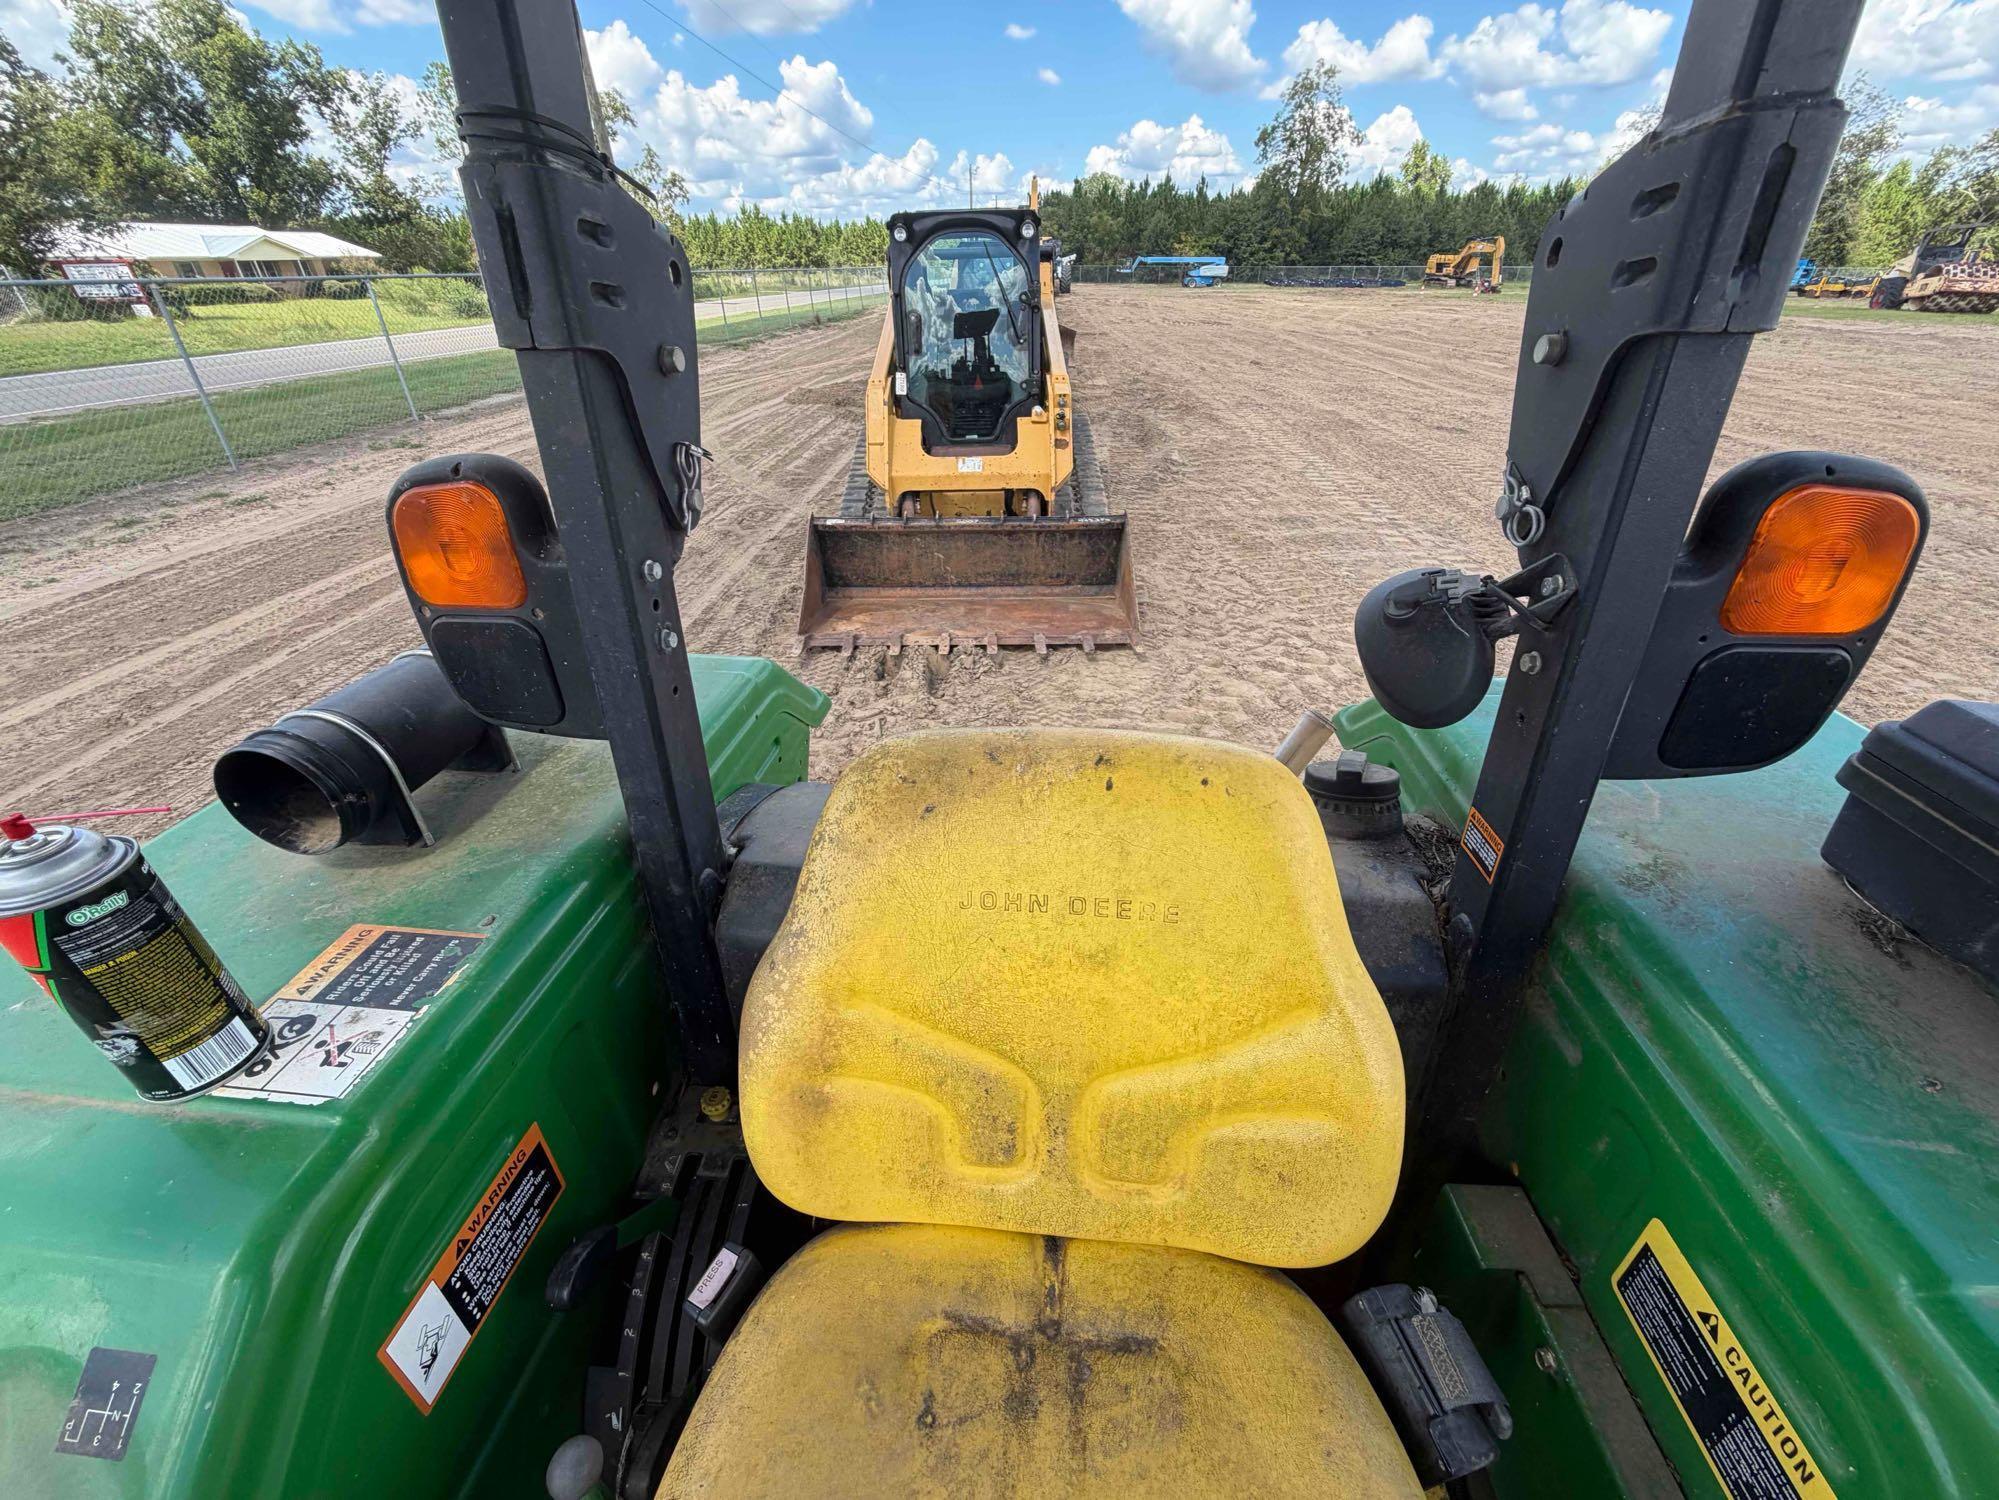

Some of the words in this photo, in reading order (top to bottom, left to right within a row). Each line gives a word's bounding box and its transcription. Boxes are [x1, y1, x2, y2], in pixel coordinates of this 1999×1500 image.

[69, 893, 128, 924] O'Reilly
[958, 890, 1050, 914] JOHN
[1068, 896, 1180, 924] DEERE
[308, 929, 373, 981] WARNING
[326, 973, 361, 1000] Riders
[356, 949, 385, 971] Could
[380, 934, 402, 948] Fall
[352, 964, 398, 1002] Seriously
[393, 936, 426, 962] Injured
[355, 975, 372, 987] Off
[369, 959, 389, 973] and
[386, 947, 400, 957] Be
[384, 977, 397, 985] or
[396, 953, 422, 975] Killed
[389, 983, 417, 1005] Never
[413, 961, 440, 982] Carry
[464, 1249, 481, 1275] Keep
[480, 1211, 505, 1249] Rollover
[505, 1168, 533, 1211] Protective
[468, 1149, 526, 1232] WARNING
[449, 1251, 472, 1286] AVOID
[471, 1198, 507, 1253] CRUSHING:
[467, 1235, 496, 1280] Structure
[495, 1214, 509, 1236] fully
[467, 1281, 486, 1312] When
[485, 1240, 512, 1283] structure
[511, 1217, 526, 1241] must
[525, 1205, 533, 1218] be
[470, 1269, 481, 1285] Do
[480, 1252, 491, 1270] not
[490, 1228, 507, 1254] jump
[511, 1184, 534, 1221] machine
[473, 1269, 486, 1290] Use
[486, 1248, 499, 1270] seat
[499, 1227, 512, 1249] belt.
[481, 1283, 492, 1301] DO
[491, 1261, 505, 1284] NOT
[504, 1244, 516, 1263] use
[515, 1224, 528, 1245] seat
[527, 1205, 540, 1226] belt.
[483, 1278, 501, 1306] Drive
[500, 1257, 513, 1280] with
[512, 1235, 527, 1259] extra
[697, 1260, 723, 1293] PRESS
[111, 1410, 122, 1421] N
[112, 1380, 121, 1392] 4
[133, 1382, 143, 1394] 2
[1726, 1346, 1816, 1486] CAUTION
[93, 1434, 102, 1446] 3
